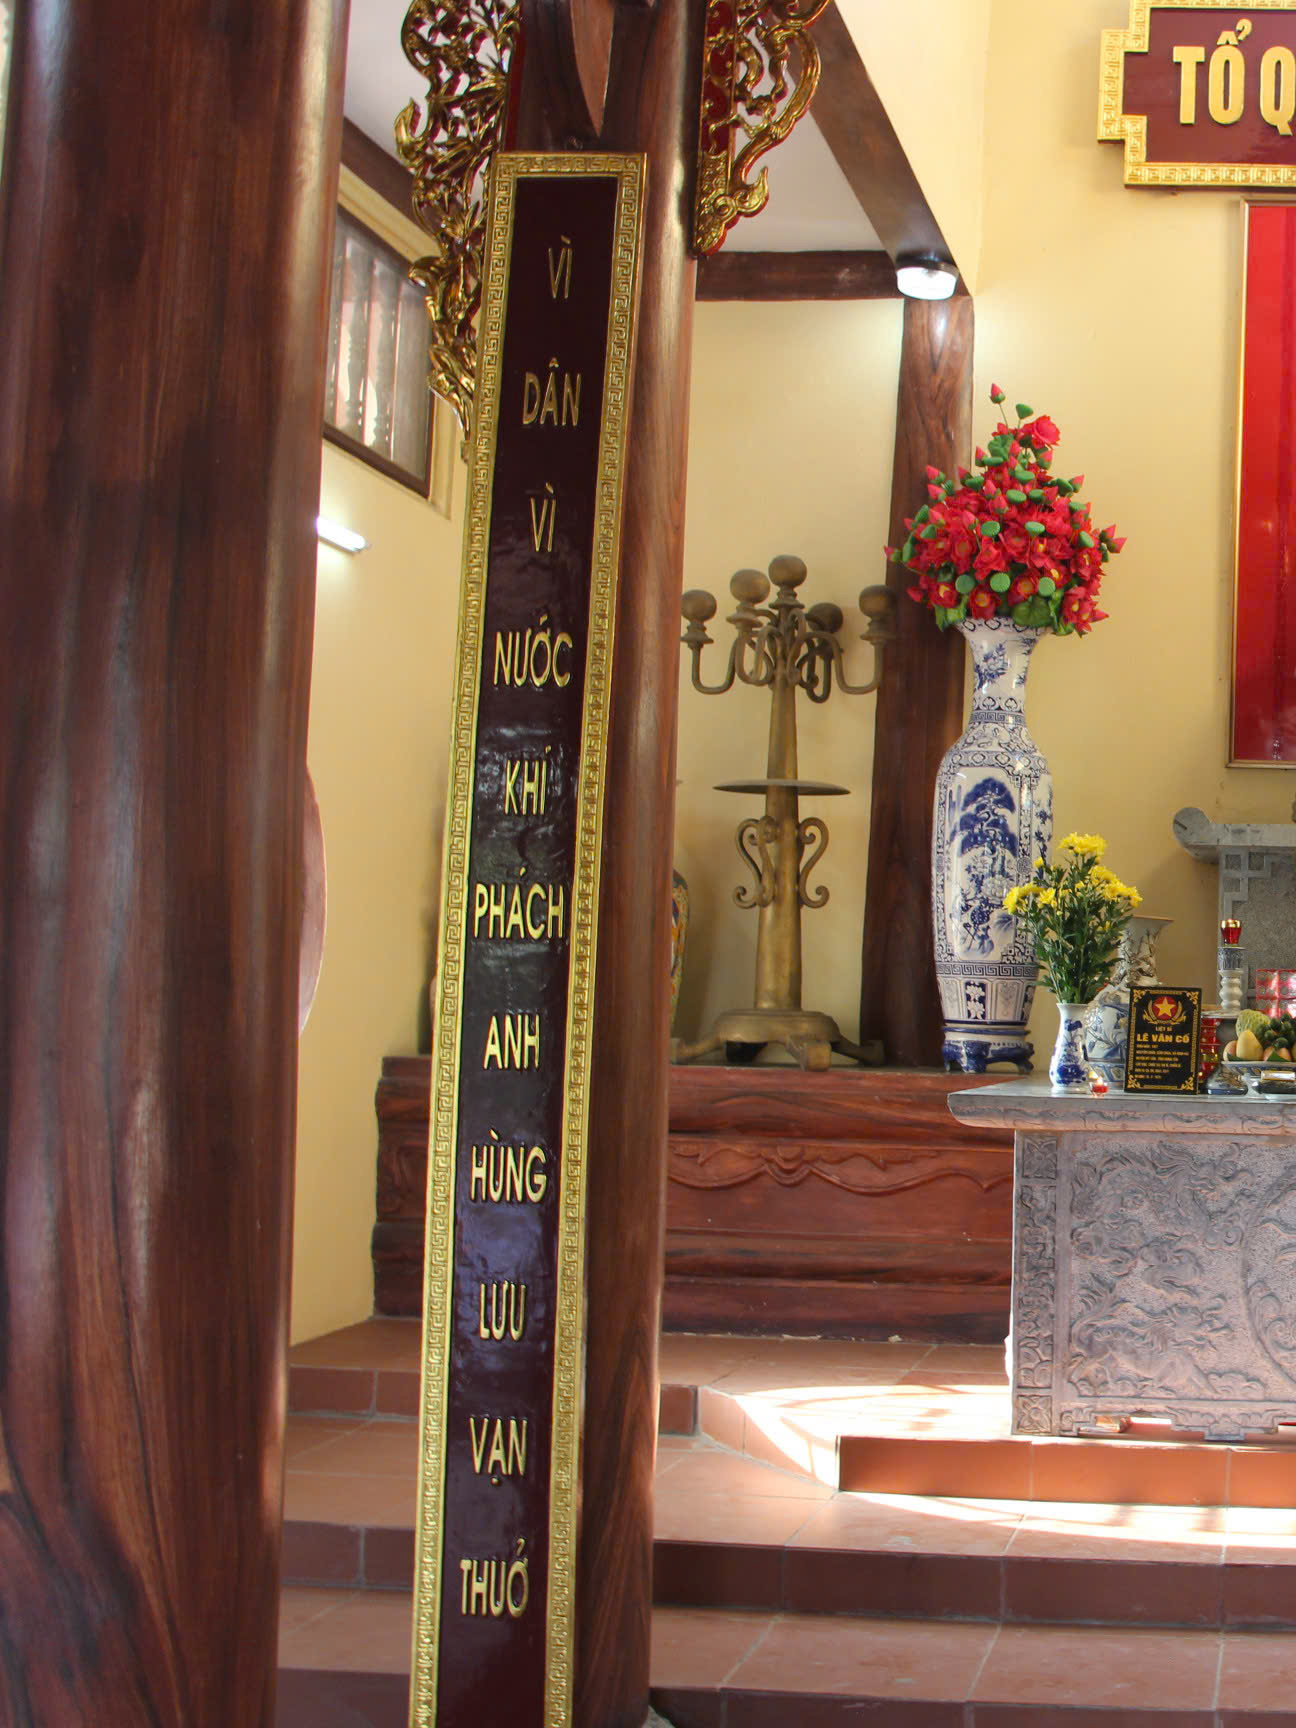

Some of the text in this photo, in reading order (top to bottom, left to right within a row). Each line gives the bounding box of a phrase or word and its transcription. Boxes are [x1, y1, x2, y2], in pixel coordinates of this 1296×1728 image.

[1172, 19, 1252, 125] TỔ
[459, 235, 582, 1617] VÌ DÂN VÌ NƯỚC KHÍ PHÁCH ANH HÙNG LƯU VẠN THUỞ
[1136, 1032, 1149, 1042] LÊ
